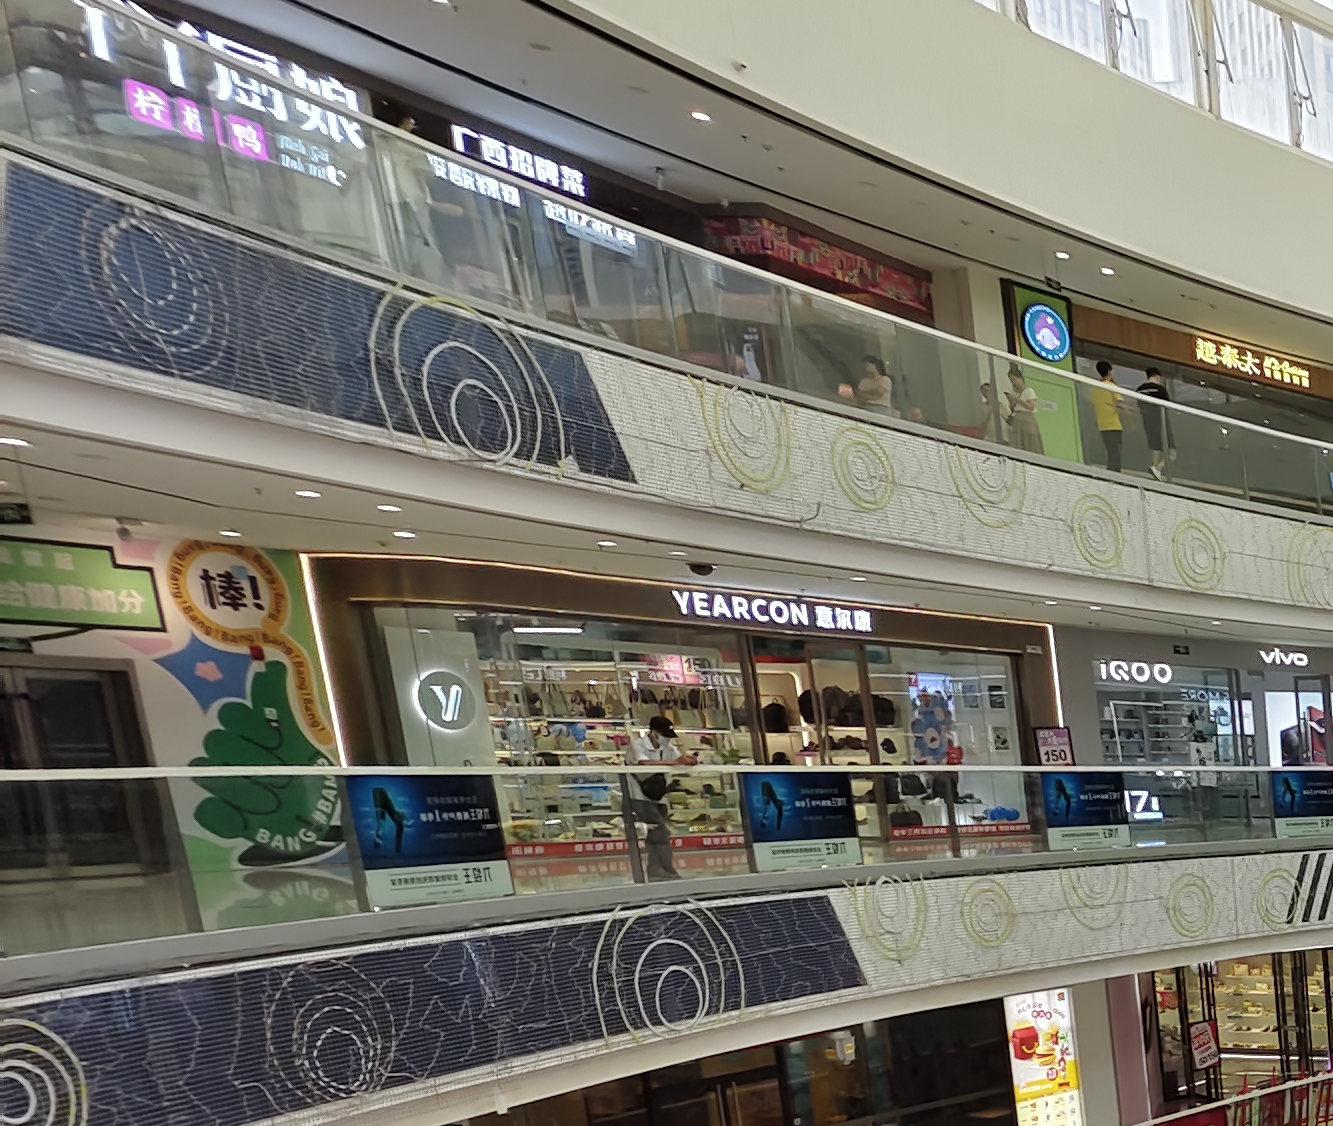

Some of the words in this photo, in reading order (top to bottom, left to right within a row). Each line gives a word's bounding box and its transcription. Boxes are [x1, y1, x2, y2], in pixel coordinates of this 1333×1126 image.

[451, 124, 588, 198] 广西招牌菜
[199, 568, 266, 612] 棒!
[672, 589, 809, 626] YEARCON
[1100, 660, 1172, 684] iQOO
[1259, 647, 1309, 667] vivo
[1044, 749, 1068, 763] 150
